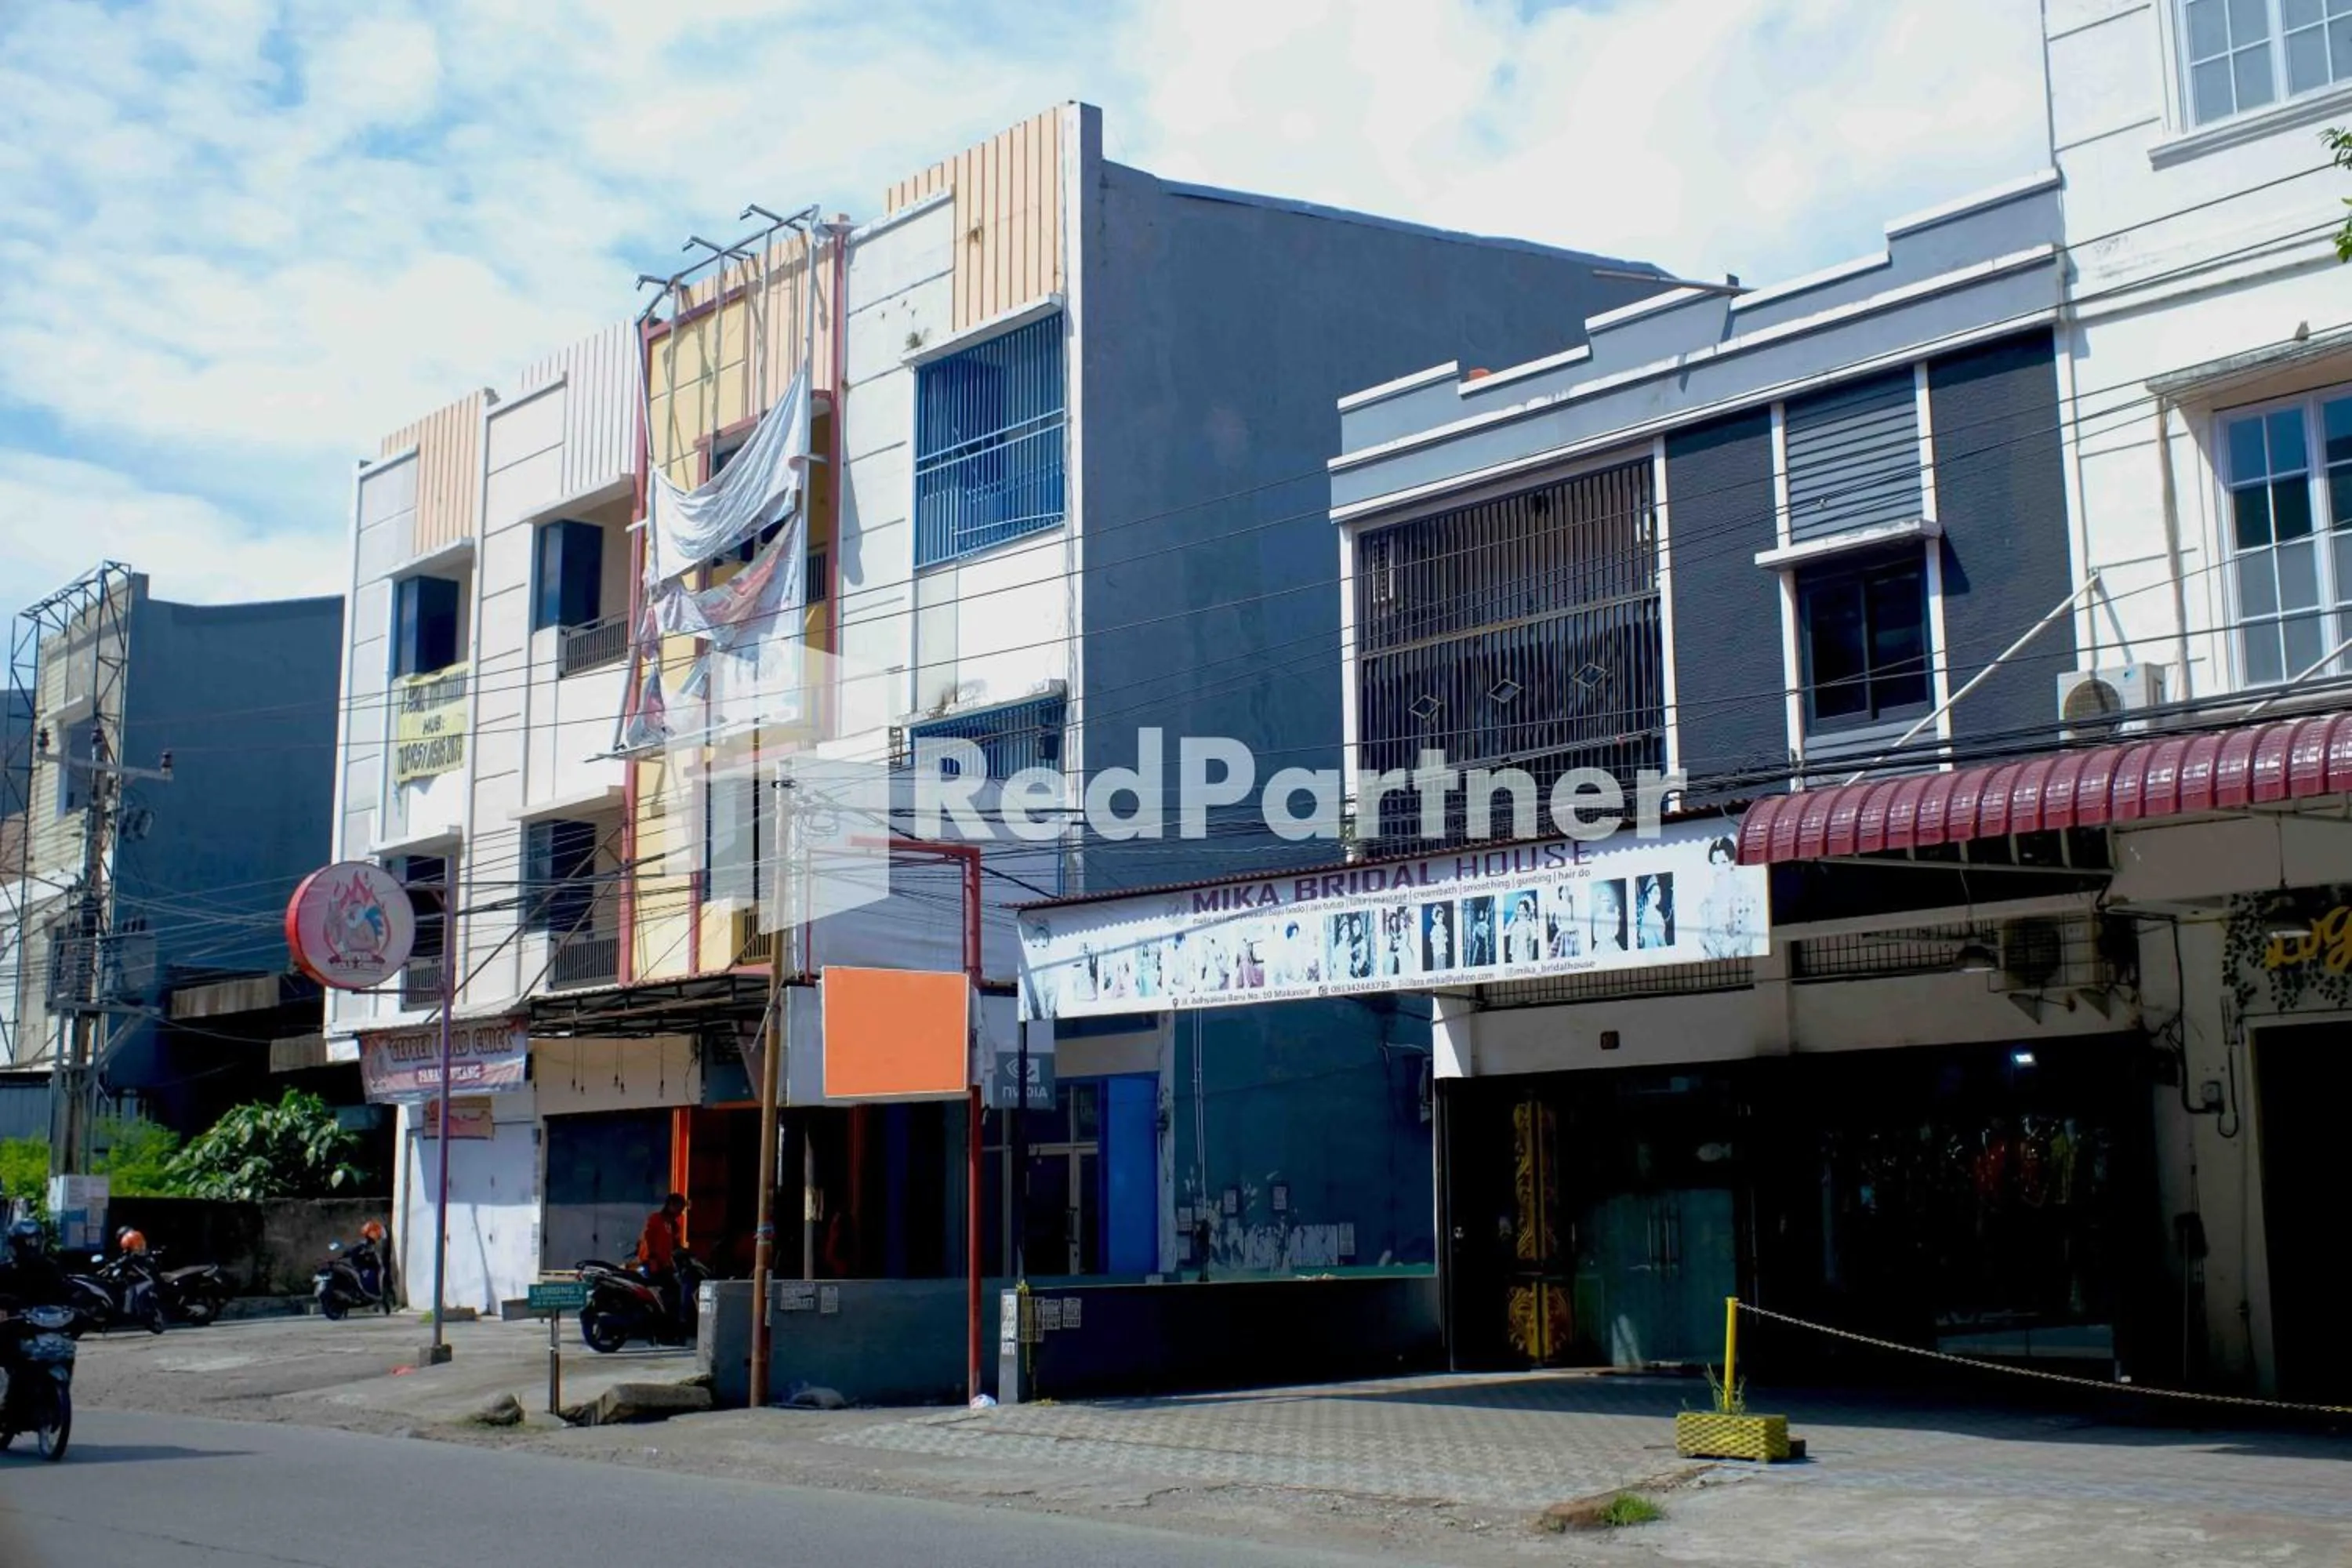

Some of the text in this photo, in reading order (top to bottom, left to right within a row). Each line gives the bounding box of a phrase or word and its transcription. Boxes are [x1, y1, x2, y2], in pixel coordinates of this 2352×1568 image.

[1192, 840, 1592, 914] MIKA BRIDAL HOUSE
[1463, 879, 1511, 893] smoothing
[1517, 873, 1552, 887] gunting
[1559, 869, 1576, 880] hair
[1578, 868, 1591, 878] do
